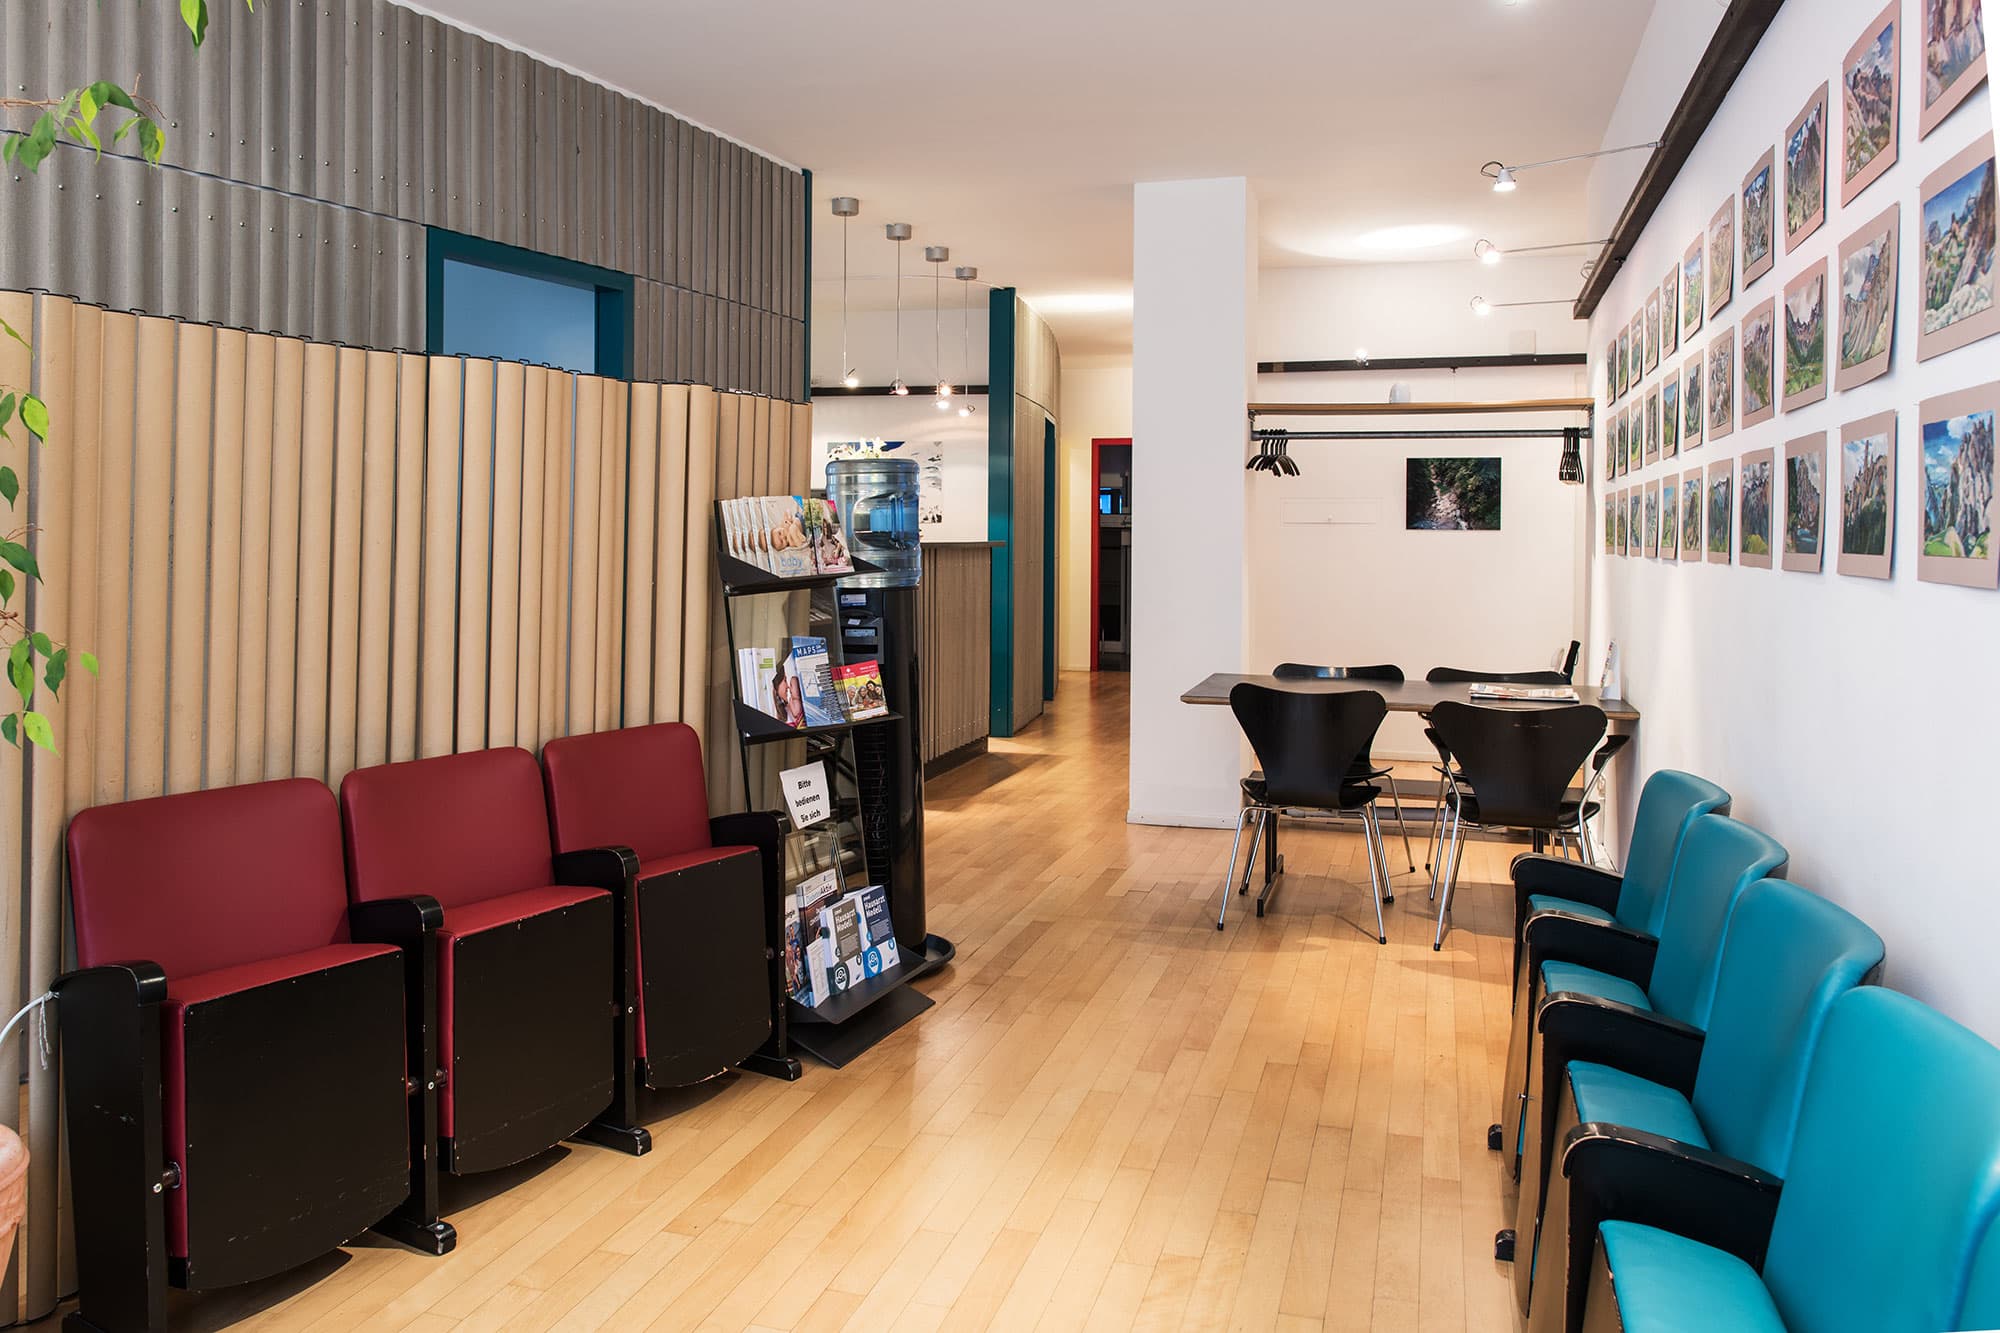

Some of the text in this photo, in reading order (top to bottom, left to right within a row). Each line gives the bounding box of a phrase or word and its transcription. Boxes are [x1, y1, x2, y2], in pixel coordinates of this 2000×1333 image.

[796, 646, 816, 657] MAPS
[798, 780, 812, 789] Bitte
[795, 794, 820, 807] bedienen
[800, 809, 821, 823] Sie sich
